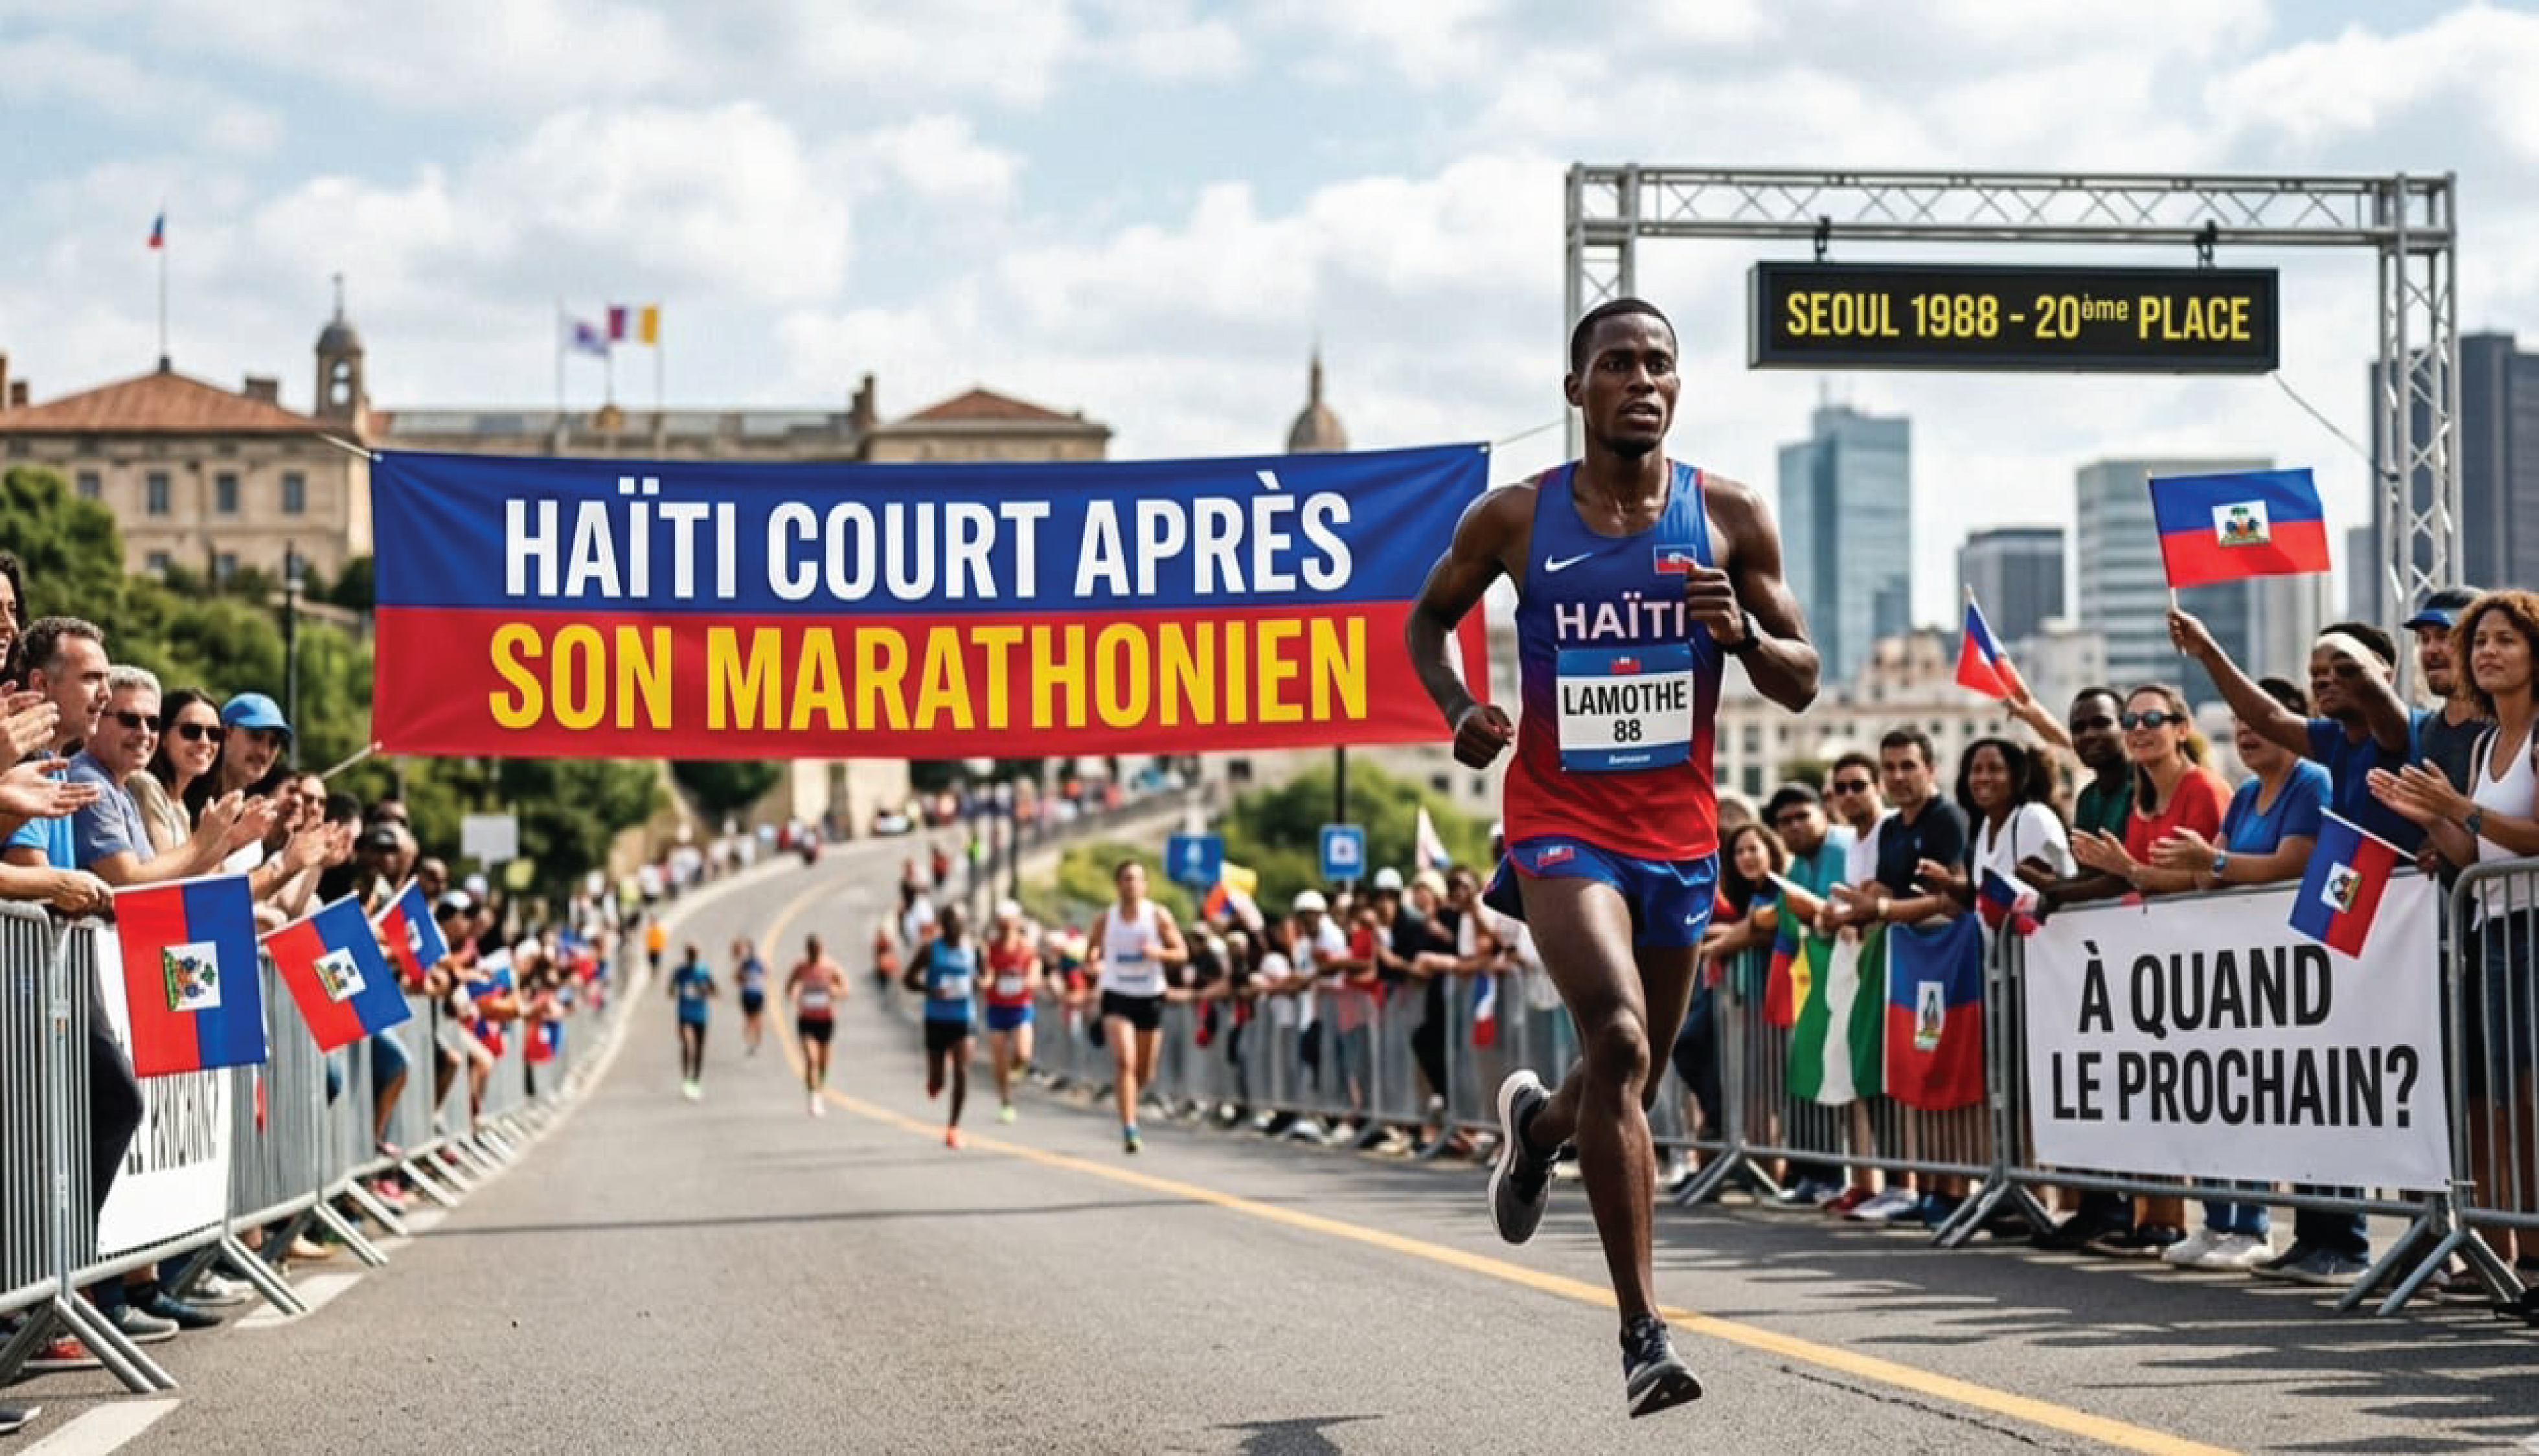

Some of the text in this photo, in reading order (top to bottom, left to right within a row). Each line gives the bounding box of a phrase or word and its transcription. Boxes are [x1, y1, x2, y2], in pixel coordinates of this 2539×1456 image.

[1787, 293, 1900, 336] SEOUL
[1910, 293, 1999, 337] 1988
[2035, 293, 2130, 339] 20ème
[2139, 295, 2251, 340] PLACE
[505, 471, 1352, 600] HAÏTI COURT APRÈS
[1554, 591, 1685, 640] HAÏTI
[488, 615, 1367, 731] SON MARATHONIEN
[1563, 680, 1688, 715] LAMOTHE
[1613, 718, 1643, 743] 88
[2078, 940, 2332, 1040] À QUAND
[2052, 1044, 2419, 1128] LE PROCHAIN?
